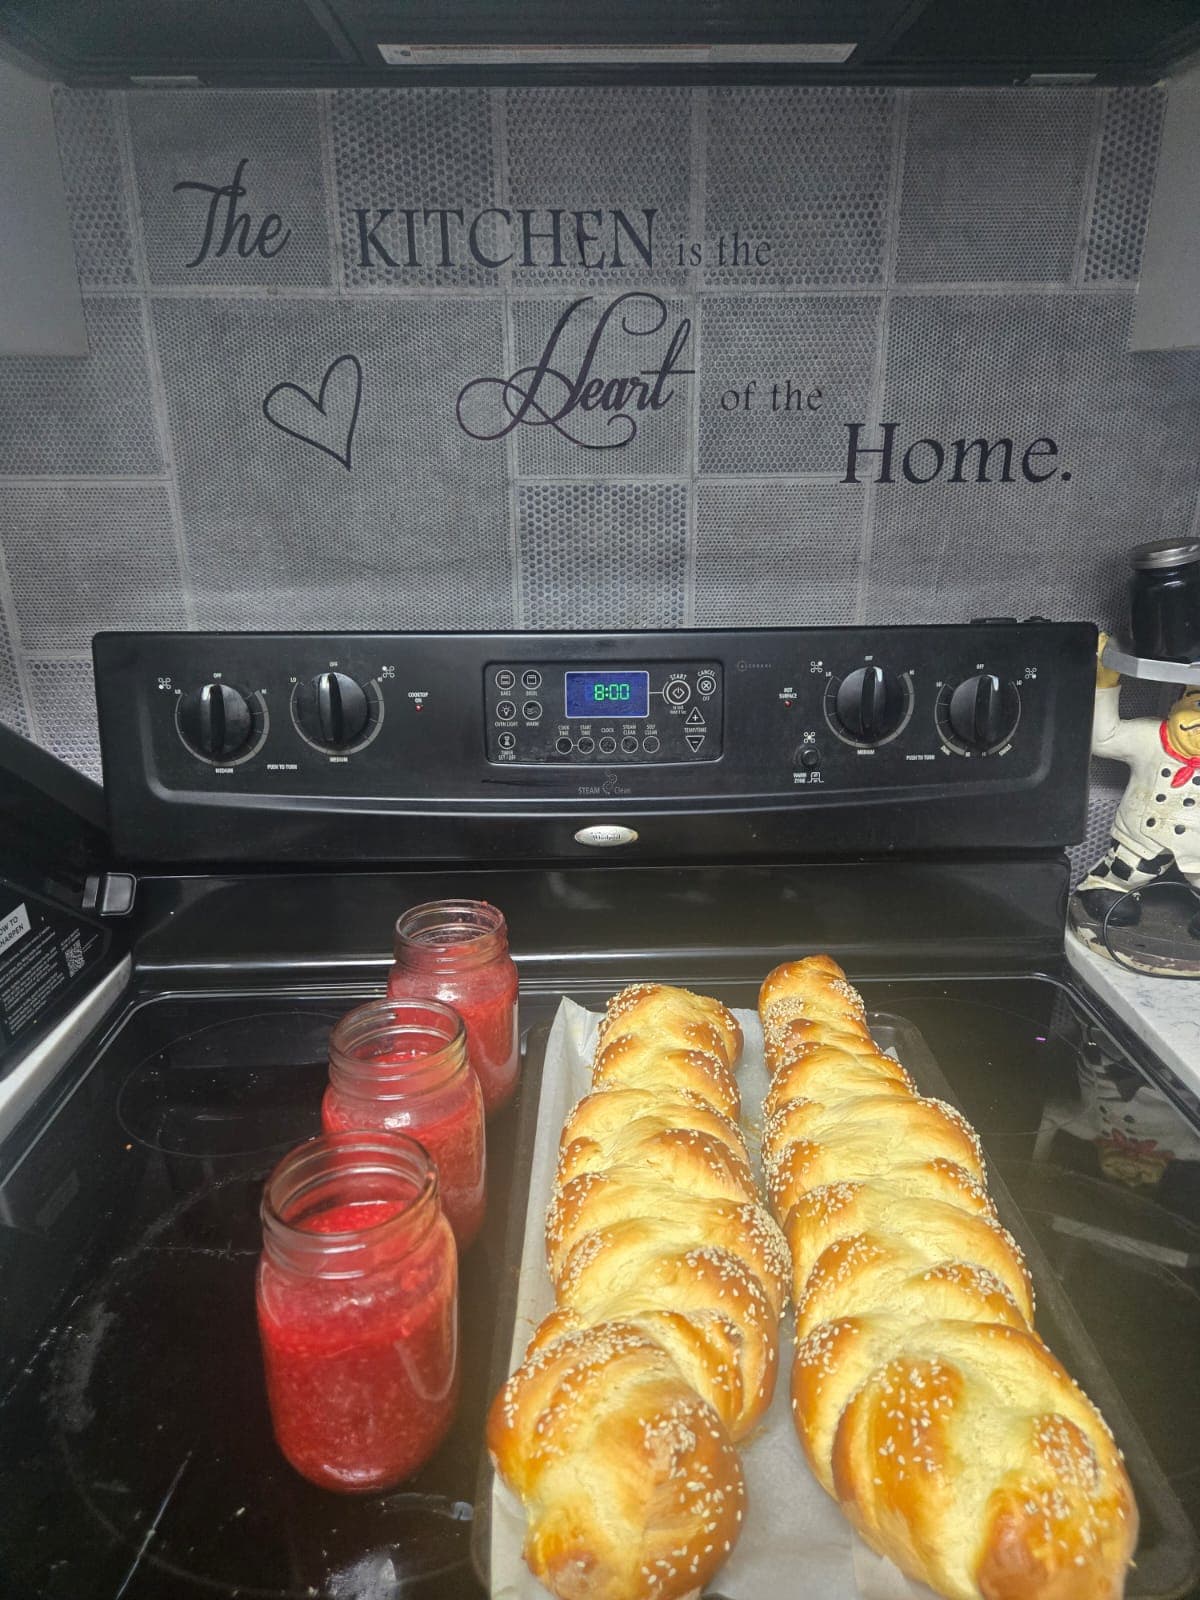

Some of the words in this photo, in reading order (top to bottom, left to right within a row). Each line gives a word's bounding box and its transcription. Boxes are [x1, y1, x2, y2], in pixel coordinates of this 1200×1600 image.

[172, 158, 292, 270] The
[352, 207, 659, 269] KITCHEN
[677, 233, 702, 268] is
[716, 233, 772, 268] the
[456, 292, 695, 450] Heart
[720, 380, 757, 412] of
[770, 380, 823, 412] the
[839, 422, 1072, 485] Home.
[669, 673, 688, 681] START
[697, 669, 716, 677] CANCEL
[594, 683, 630, 701] 8:00
[578, 786, 600, 795] STEAM
